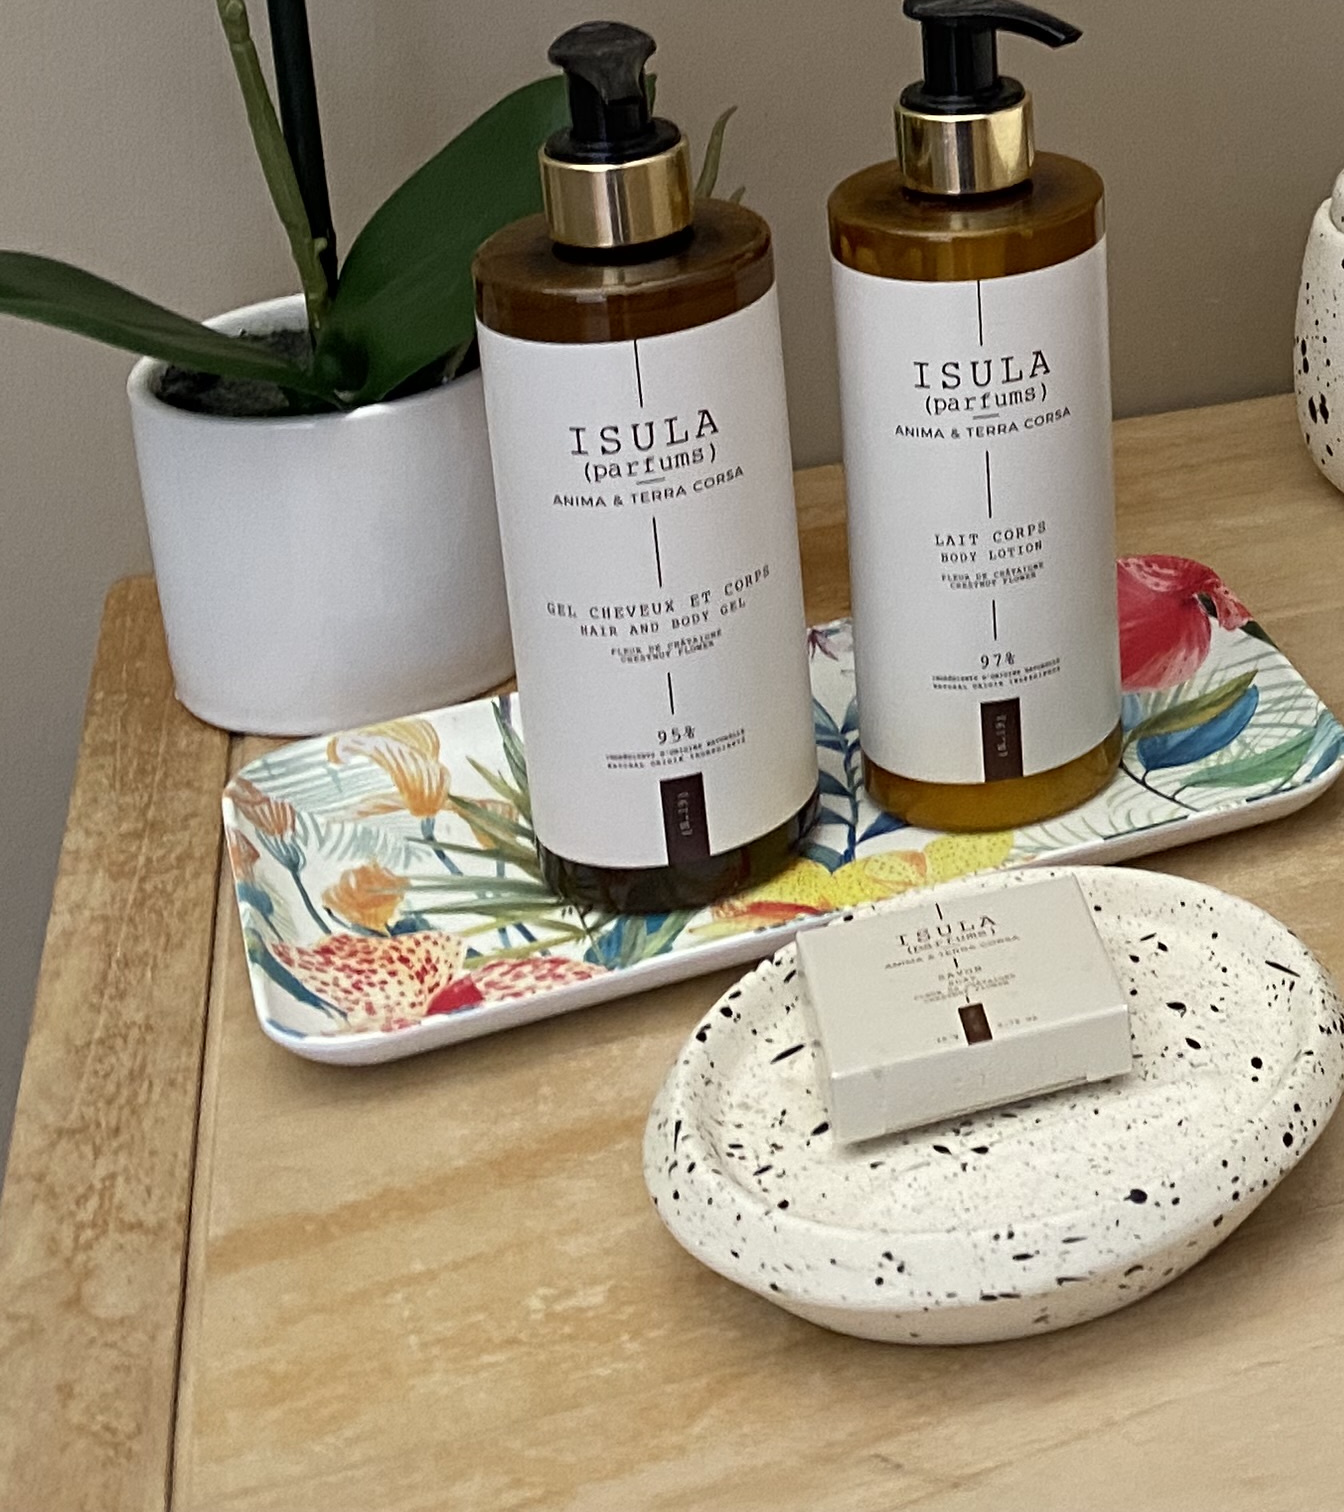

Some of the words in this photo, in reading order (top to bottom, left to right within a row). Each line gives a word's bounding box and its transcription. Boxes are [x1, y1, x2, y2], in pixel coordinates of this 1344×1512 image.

[913, 350, 1051, 389] ISULA
[925, 382, 1047, 416] (parfums)
[569, 409, 719, 455] ISULA
[895, 424, 945, 439] ANIMA
[950, 428, 960, 439] &
[966, 421, 1019, 438] TERRA
[1024, 406, 1071, 429] CORSA
[584, 442, 716, 483] (parfums)
[553, 494, 607, 507] ANIMA
[613, 494, 624, 507] &
[631, 485, 687, 504] TERRA
[692, 465, 744, 492] CORSA
[935, 533, 978, 546] LAIT
[993, 520, 1046, 543] CORPS
[941, 551, 977, 563] BODY
[989, 540, 1042, 561] LOTION
[547, 602, 577, 618] GEL
[589, 599, 675, 620] CHEVEUX
[690, 590, 711, 608] ET
[724, 564, 770, 596] CORPS
[580, 624, 618, 637] HAIR
[629, 623, 659, 636] AND
[671, 610, 710, 629] BODY
[720, 597, 746, 616] GEL
[896, 915, 996, 946] ISULA
